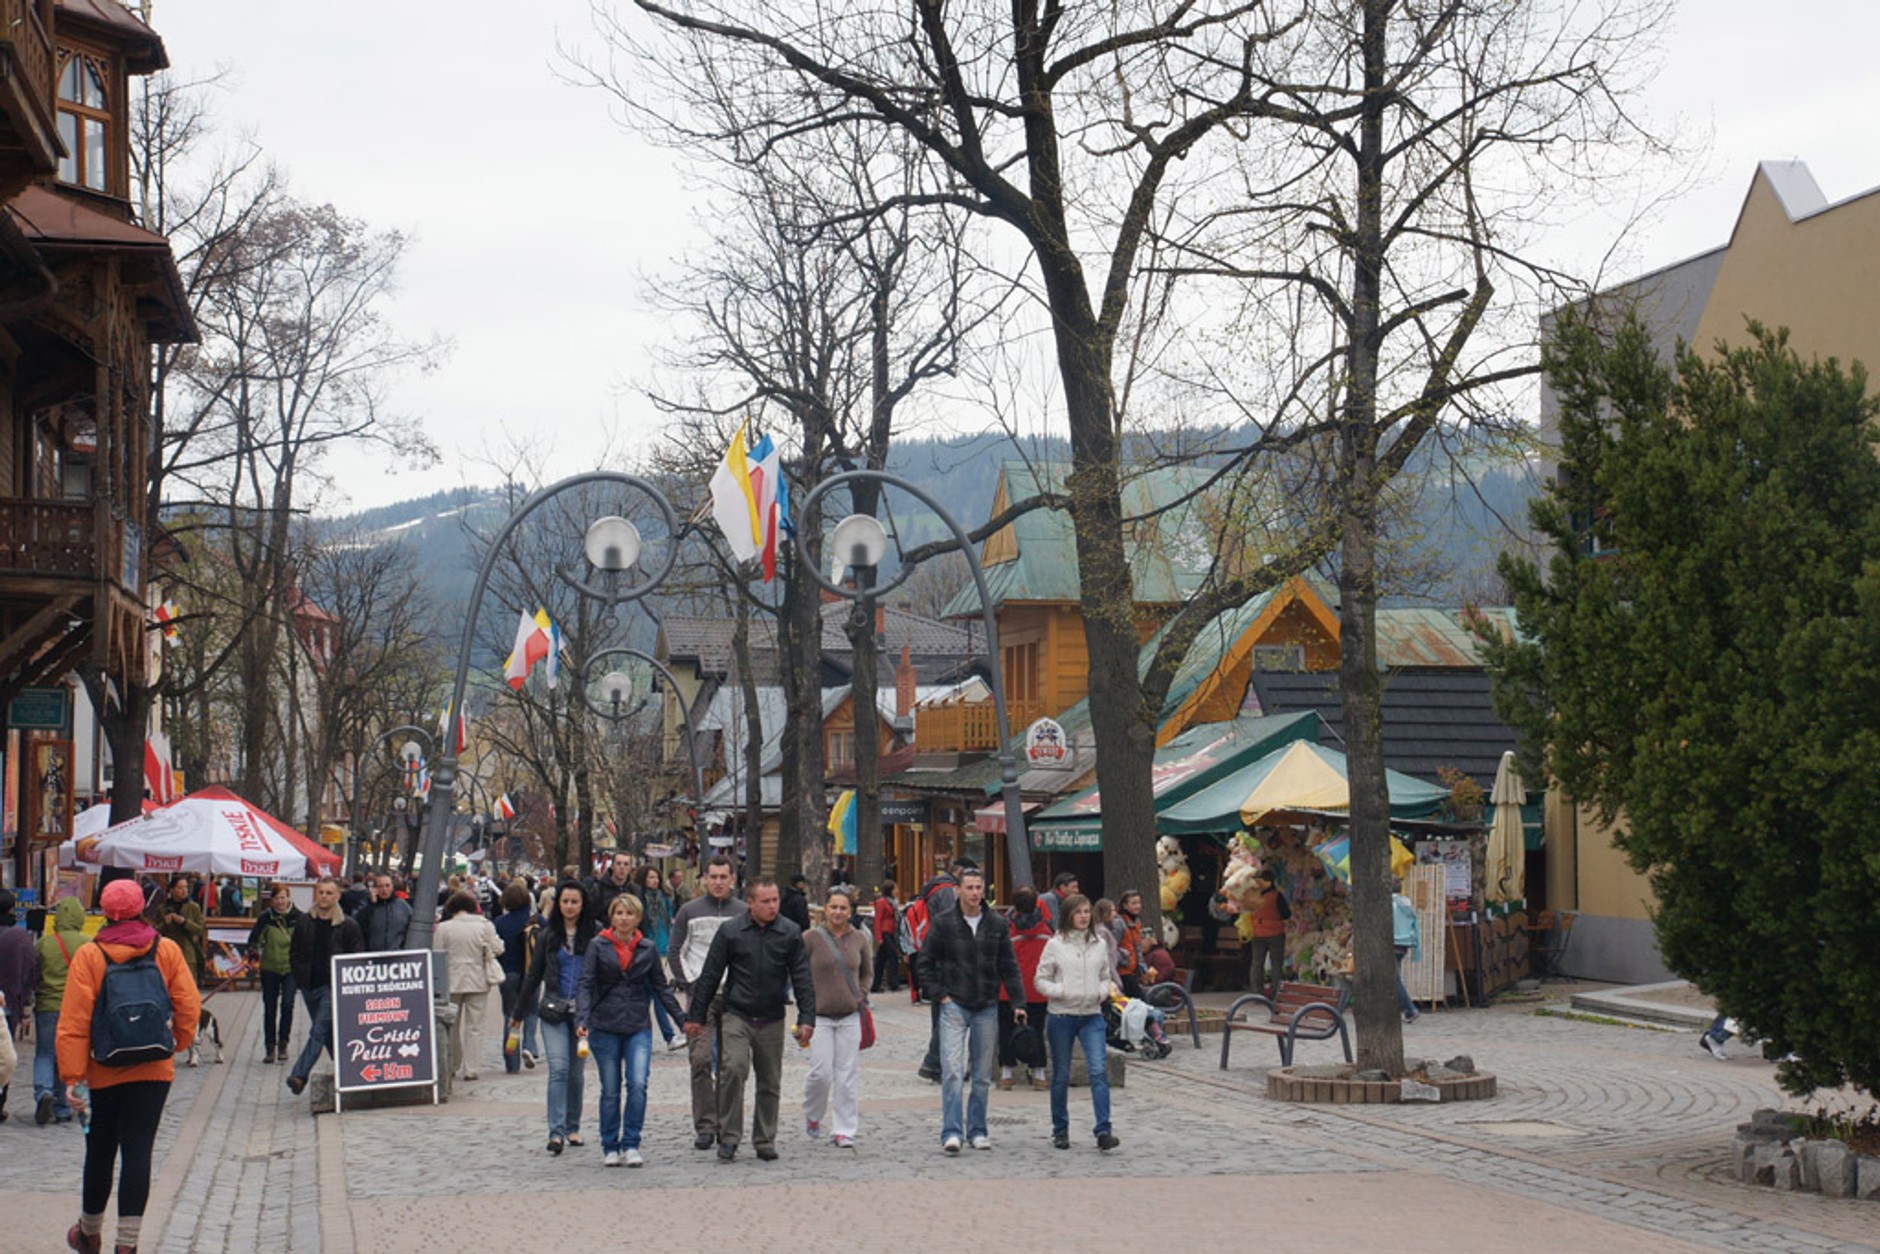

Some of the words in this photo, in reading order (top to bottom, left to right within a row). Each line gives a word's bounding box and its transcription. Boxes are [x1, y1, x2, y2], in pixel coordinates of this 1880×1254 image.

[221, 810, 262, 851] TYSKIE
[147, 856, 180, 870] TYSKIE
[243, 860, 277, 874] TYSKIE
[341, 960, 422, 983] KOŻUCHY
[341, 984, 376, 995] KURTKI
[377, 980, 424, 993] SKÓRZANE
[365, 997, 401, 1011] SALON
[358, 1009, 410, 1025] FIRMOWY
[366, 1026, 421, 1043] Cristo
[346, 1039, 392, 1062] Pelli
